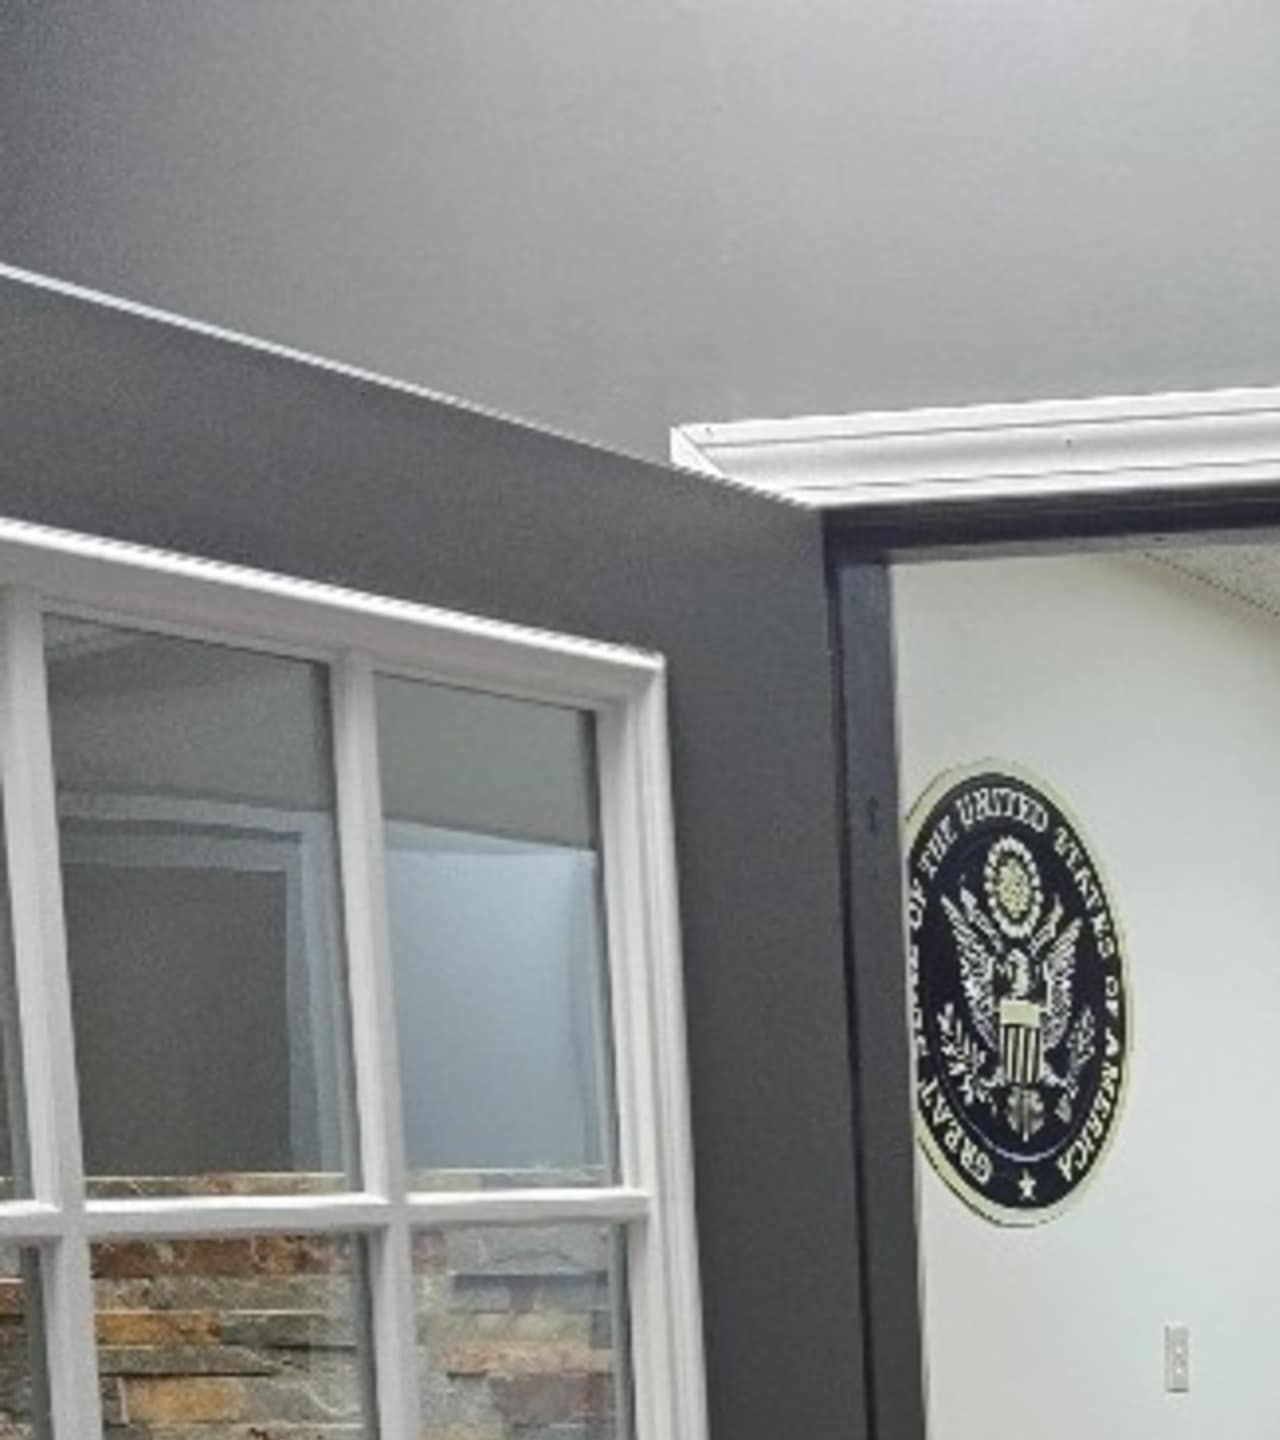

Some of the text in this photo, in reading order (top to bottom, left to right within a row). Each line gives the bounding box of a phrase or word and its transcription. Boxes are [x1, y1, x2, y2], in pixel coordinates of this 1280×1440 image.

[918, 814, 959, 880] THE
[955, 787, 1048, 832] UNITED
[1054, 826, 1116, 959] STATES
[918, 1077, 994, 1185] GREAT
[1056, 1027, 1120, 1182] AMERICA
